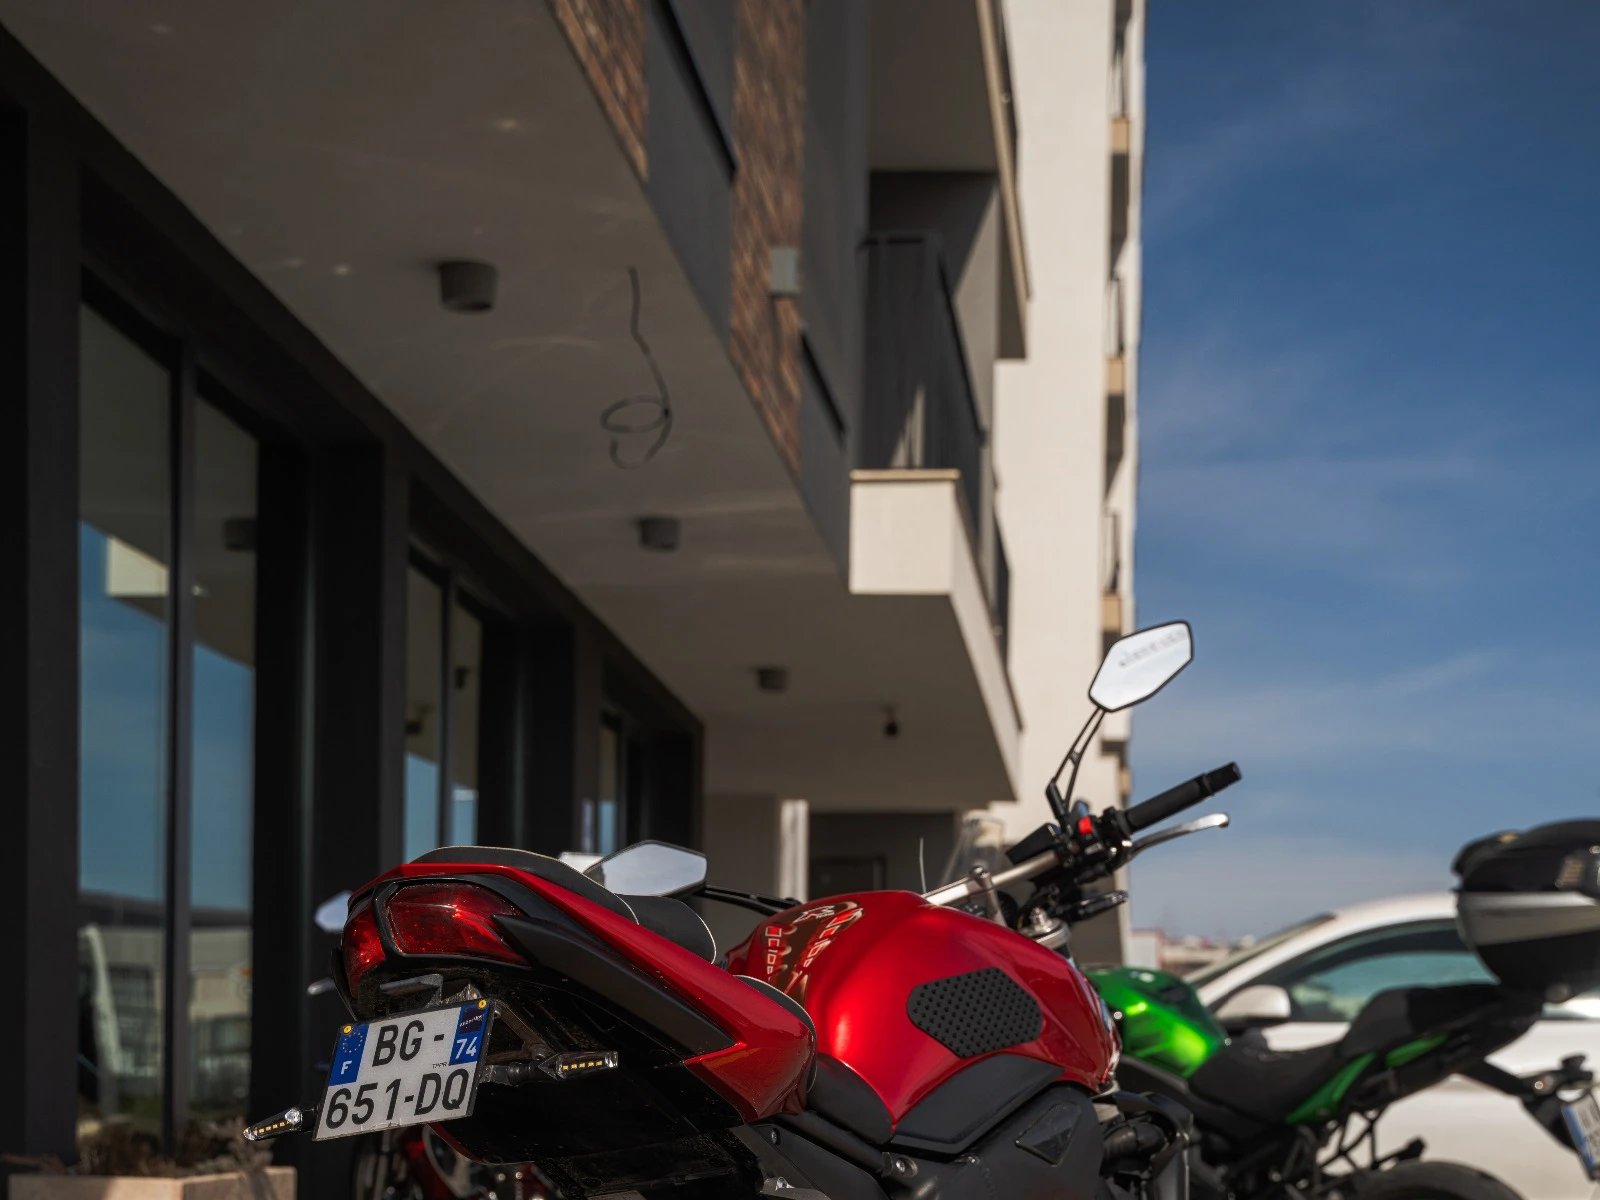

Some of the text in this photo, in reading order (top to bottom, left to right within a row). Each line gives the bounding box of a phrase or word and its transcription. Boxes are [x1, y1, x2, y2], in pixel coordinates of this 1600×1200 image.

[455, 1036, 478, 1060] 74
[340, 1060, 352, 1075] F
[325, 1068, 470, 1130] 651-DQ
